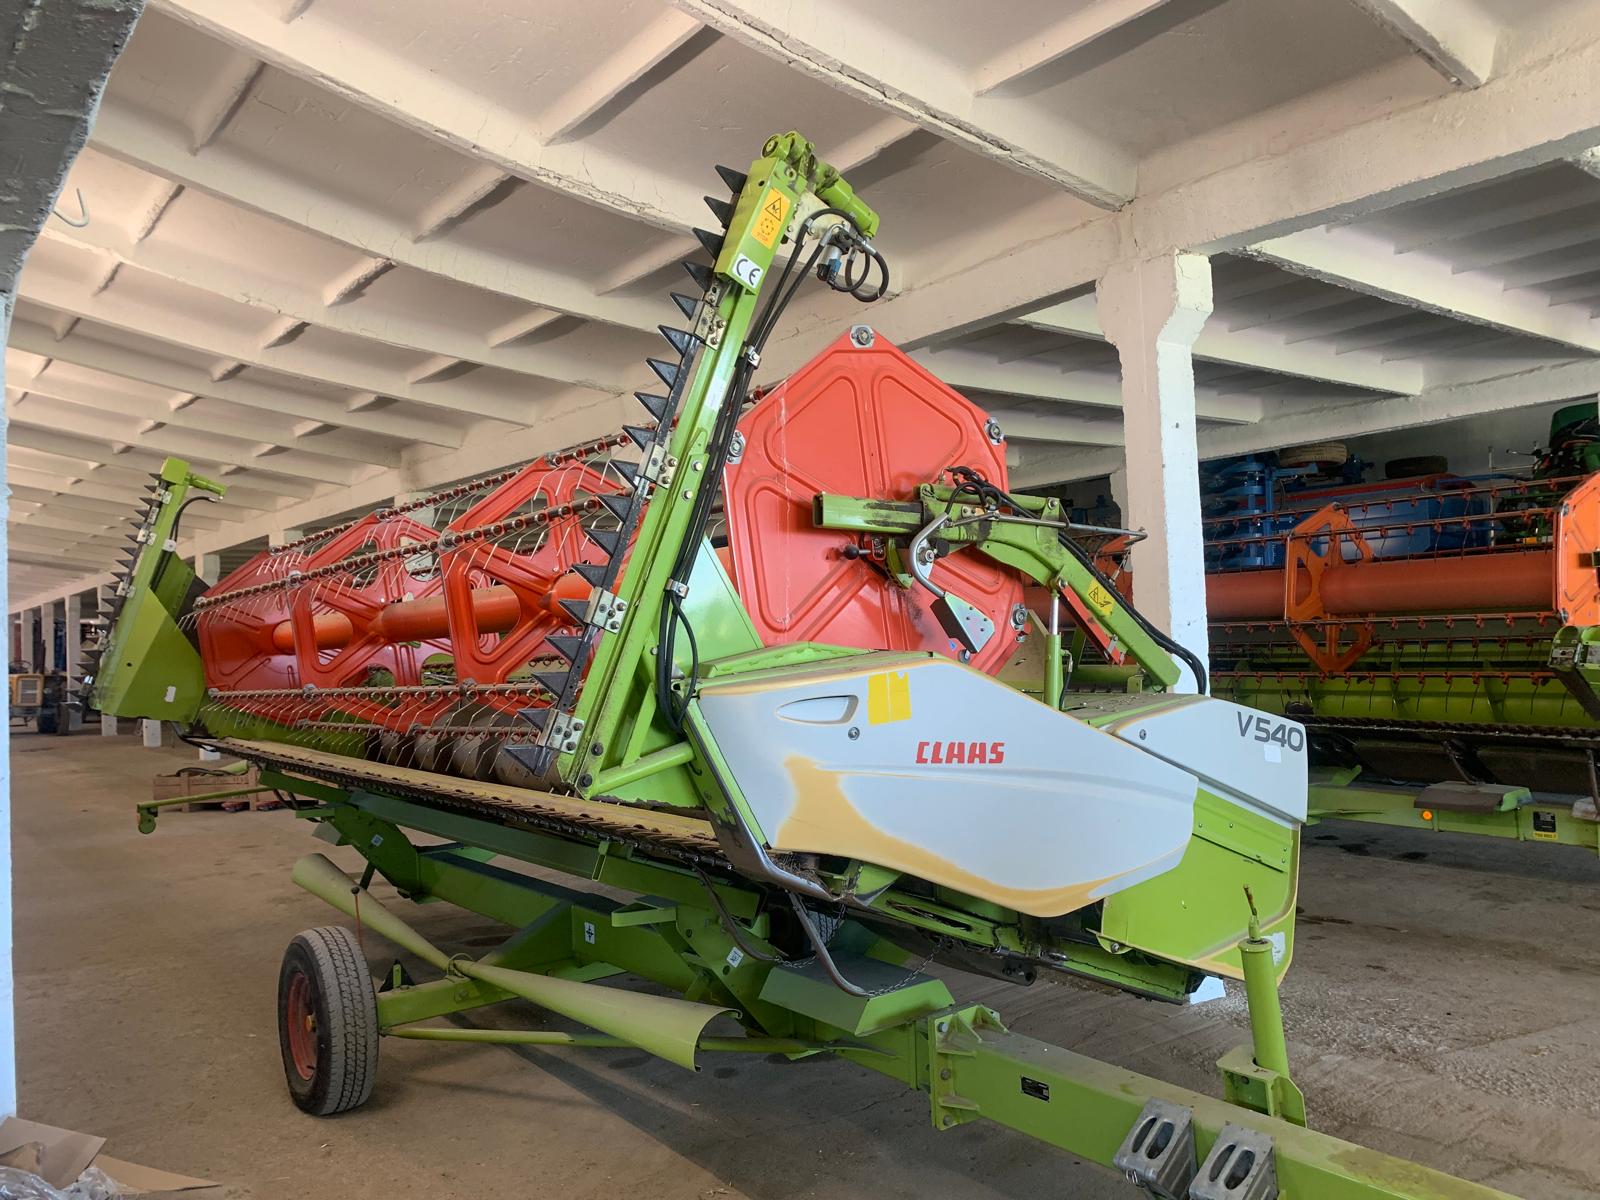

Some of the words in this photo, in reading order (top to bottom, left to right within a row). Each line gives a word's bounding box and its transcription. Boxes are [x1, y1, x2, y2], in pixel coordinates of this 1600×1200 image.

[736, 258, 761, 286] CE
[1237, 711, 1304, 752] V540
[915, 741, 1005, 764] CLAAS
